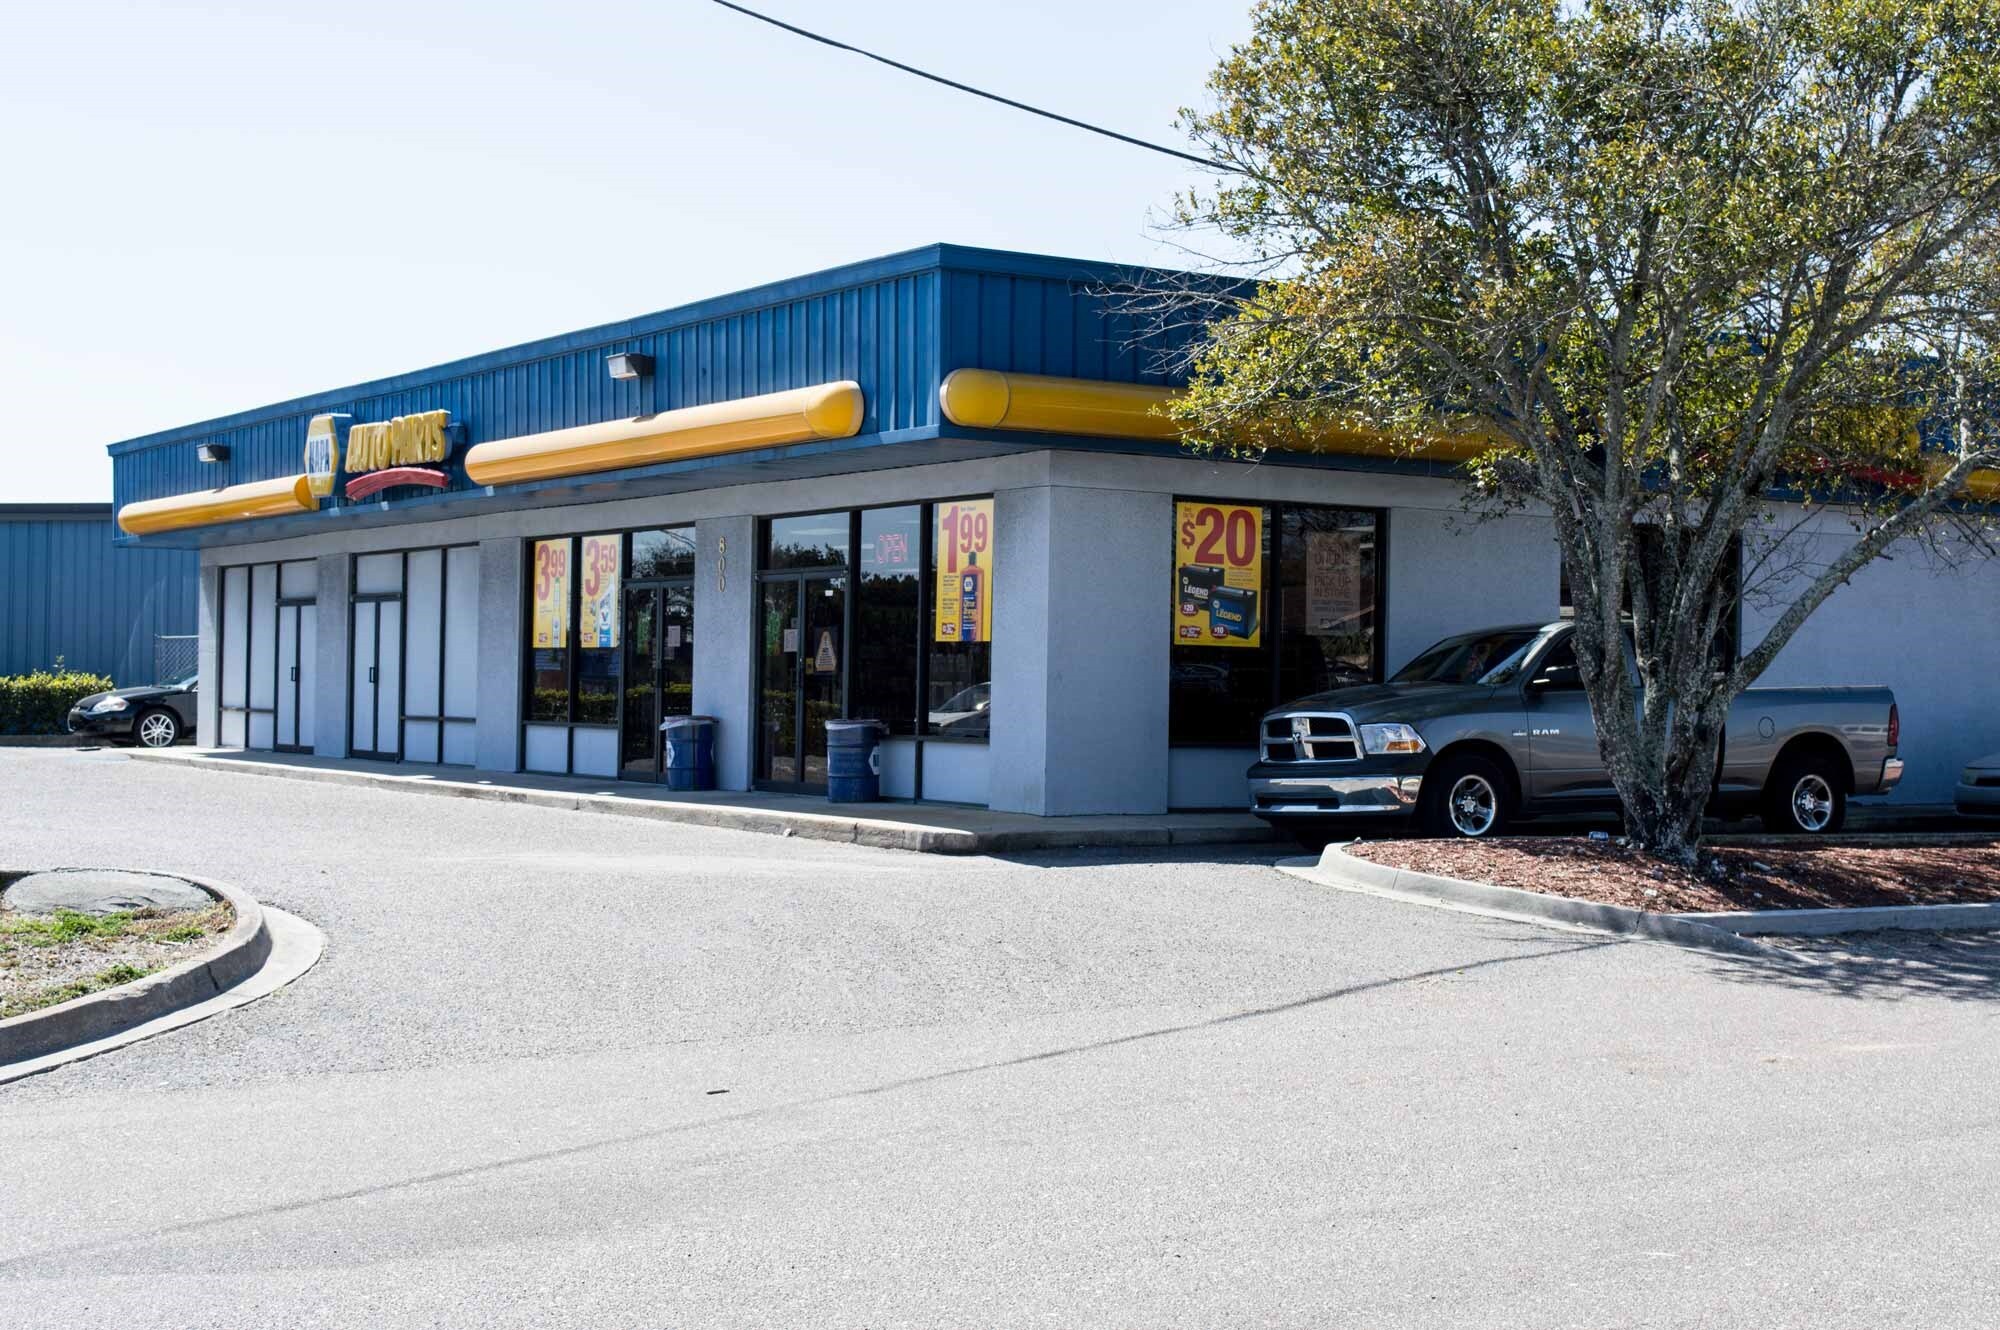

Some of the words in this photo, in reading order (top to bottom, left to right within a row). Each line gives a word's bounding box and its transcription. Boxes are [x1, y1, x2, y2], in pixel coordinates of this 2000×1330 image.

[345, 421, 392, 473] AUTO
[391, 409, 449, 465] PARTS
[1182, 507, 1257, 567] $20
[1184, 585, 1209, 596] LEGEND
[1216, 609, 1242, 622] LEGEND
